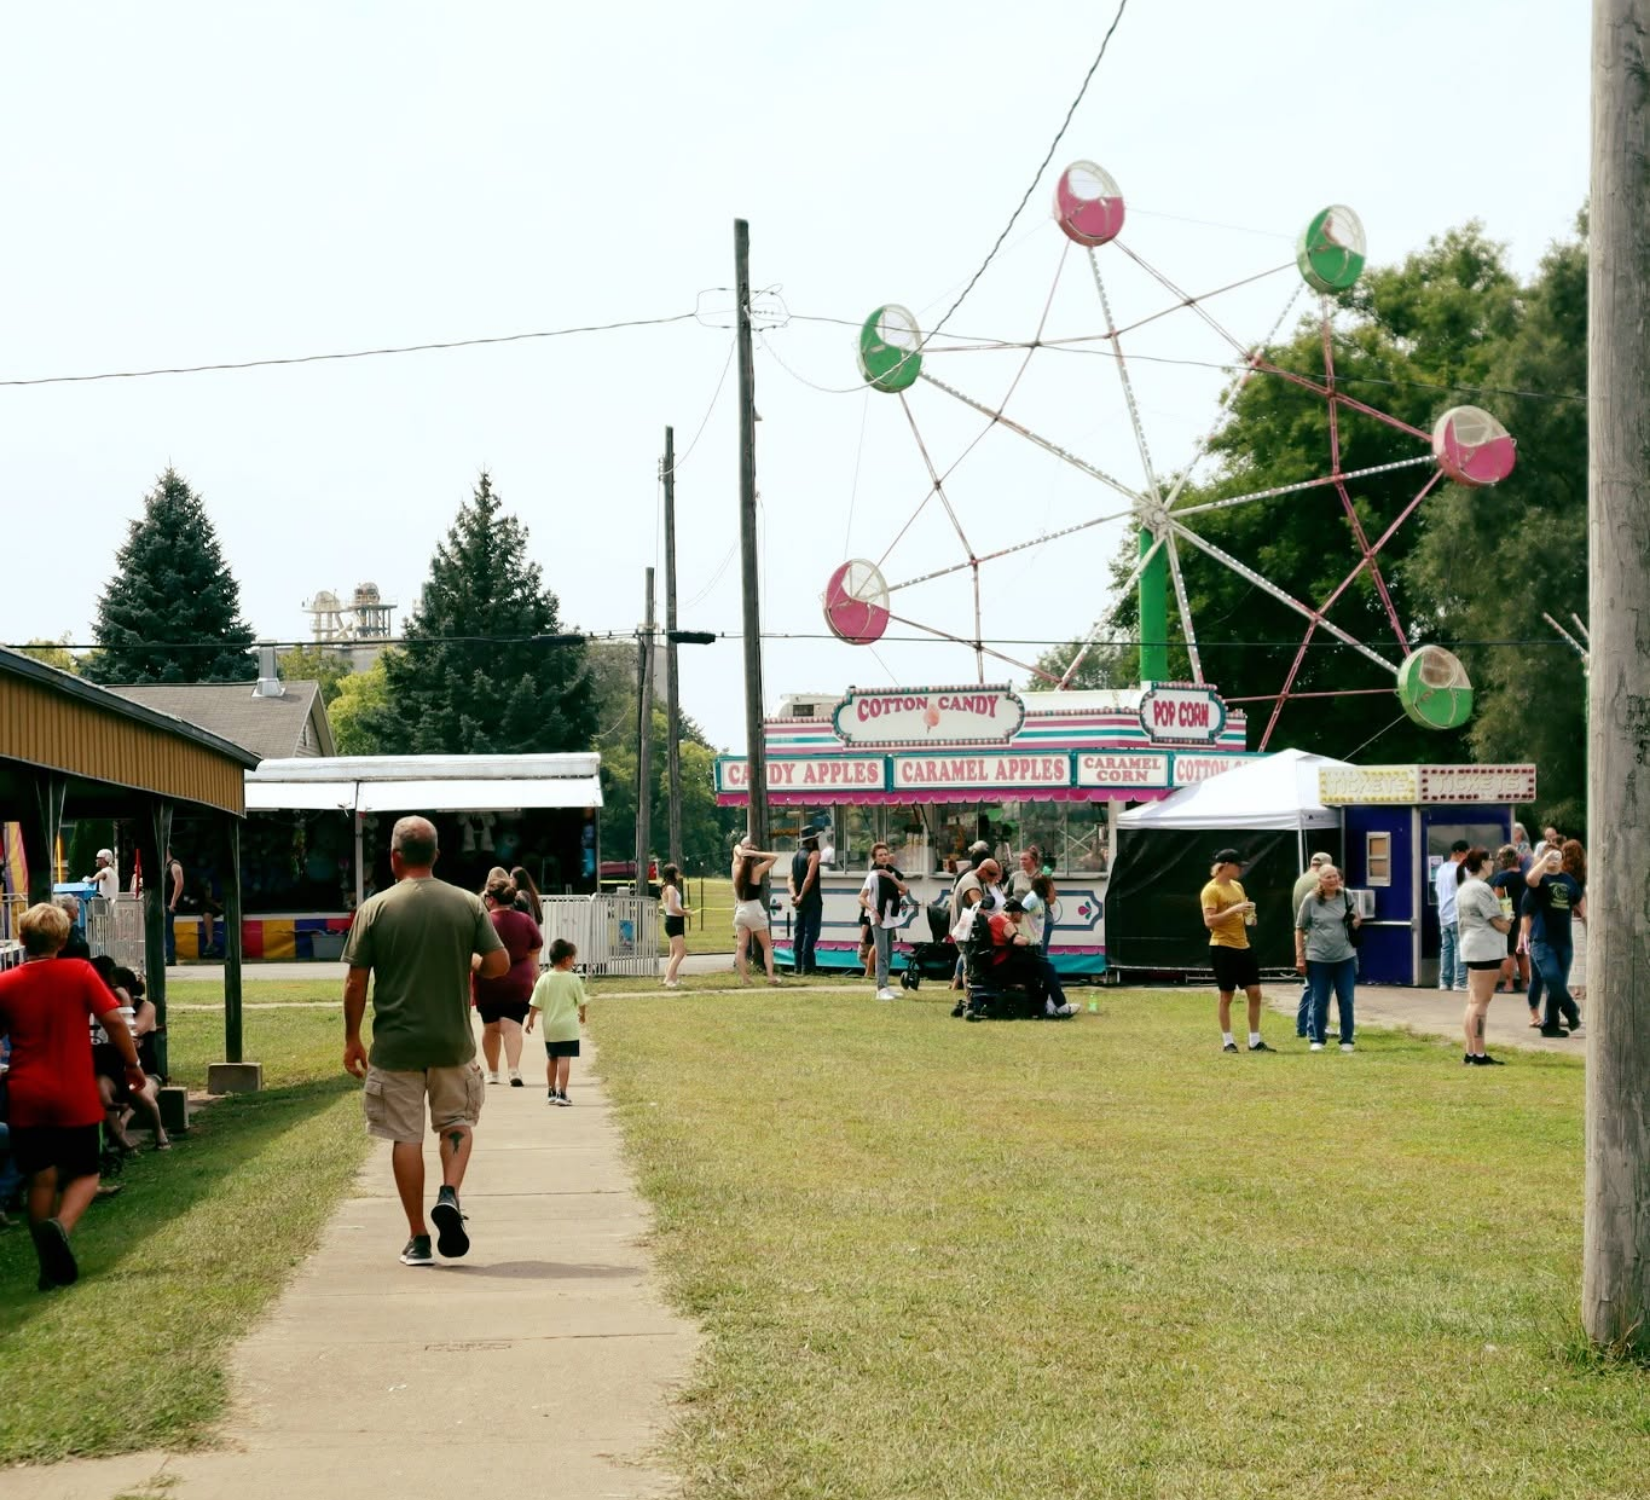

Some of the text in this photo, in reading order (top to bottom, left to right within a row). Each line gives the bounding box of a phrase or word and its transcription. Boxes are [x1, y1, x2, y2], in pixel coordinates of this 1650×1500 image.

[857, 694, 999, 722] COTTON CANDY
[1153, 700, 1209, 728] POP CORN
[728, 762, 879, 785] CADY APPLES
[902, 758, 1065, 783] CARAMEL APPLES
[1084, 757, 1161, 770] CARAMEL
[1096, 770, 1149, 782] CORN
